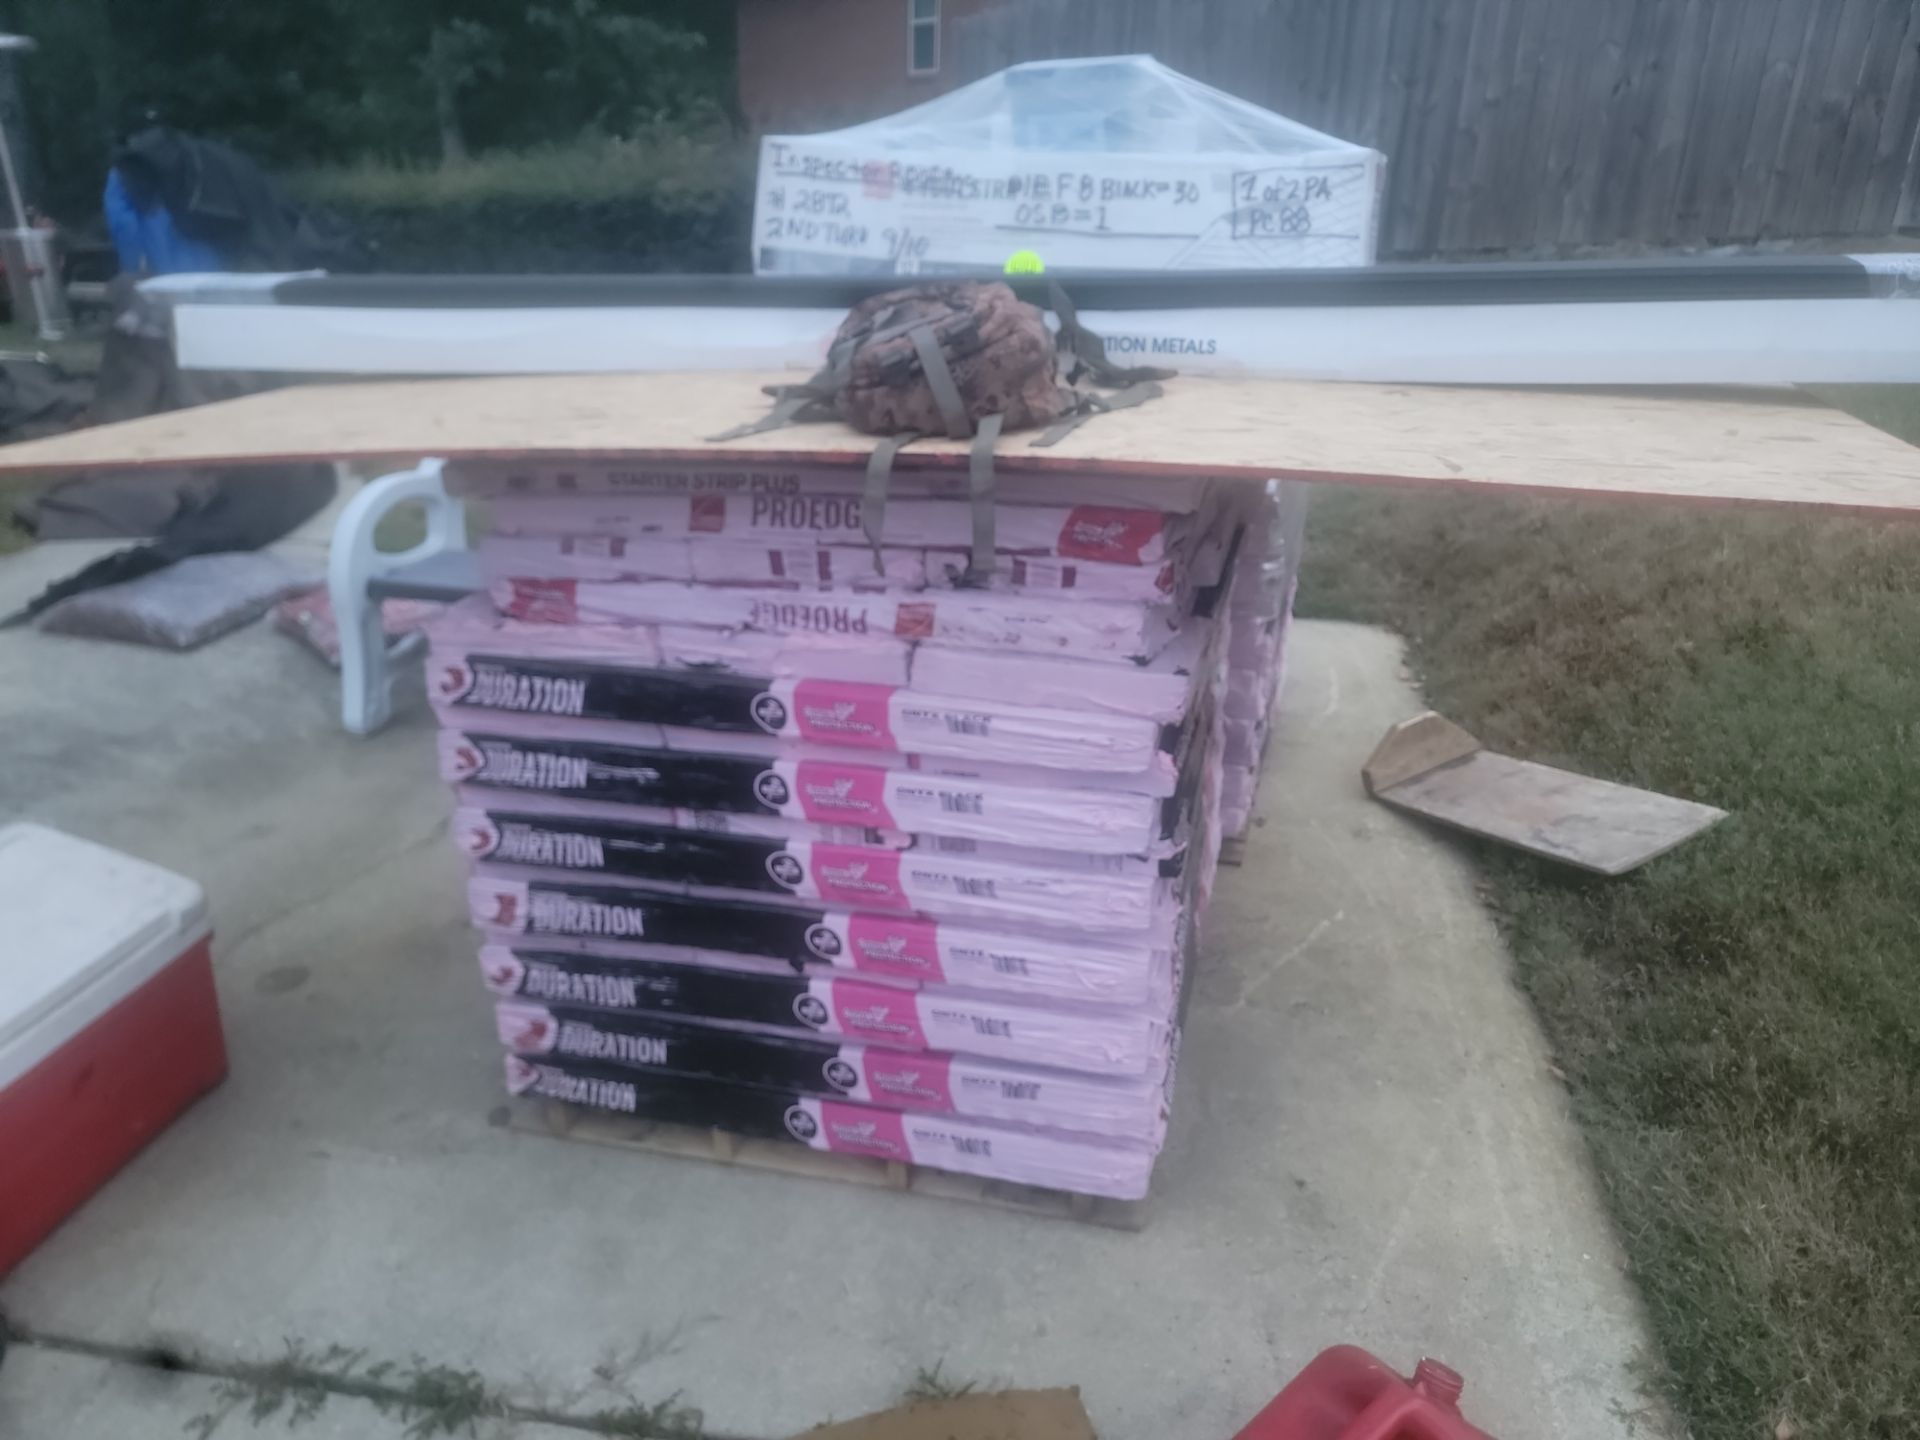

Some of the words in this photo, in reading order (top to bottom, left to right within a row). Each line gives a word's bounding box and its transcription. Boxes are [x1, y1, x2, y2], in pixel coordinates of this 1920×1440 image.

[1106, 336, 1147, 353] TION
[1153, 336, 1217, 355] METALS
[607, 471, 689, 491] STARTER
[691, 472, 747, 491] STRIP
[750, 473, 801, 496] PLUS
[750, 497, 863, 531] PROEDG
